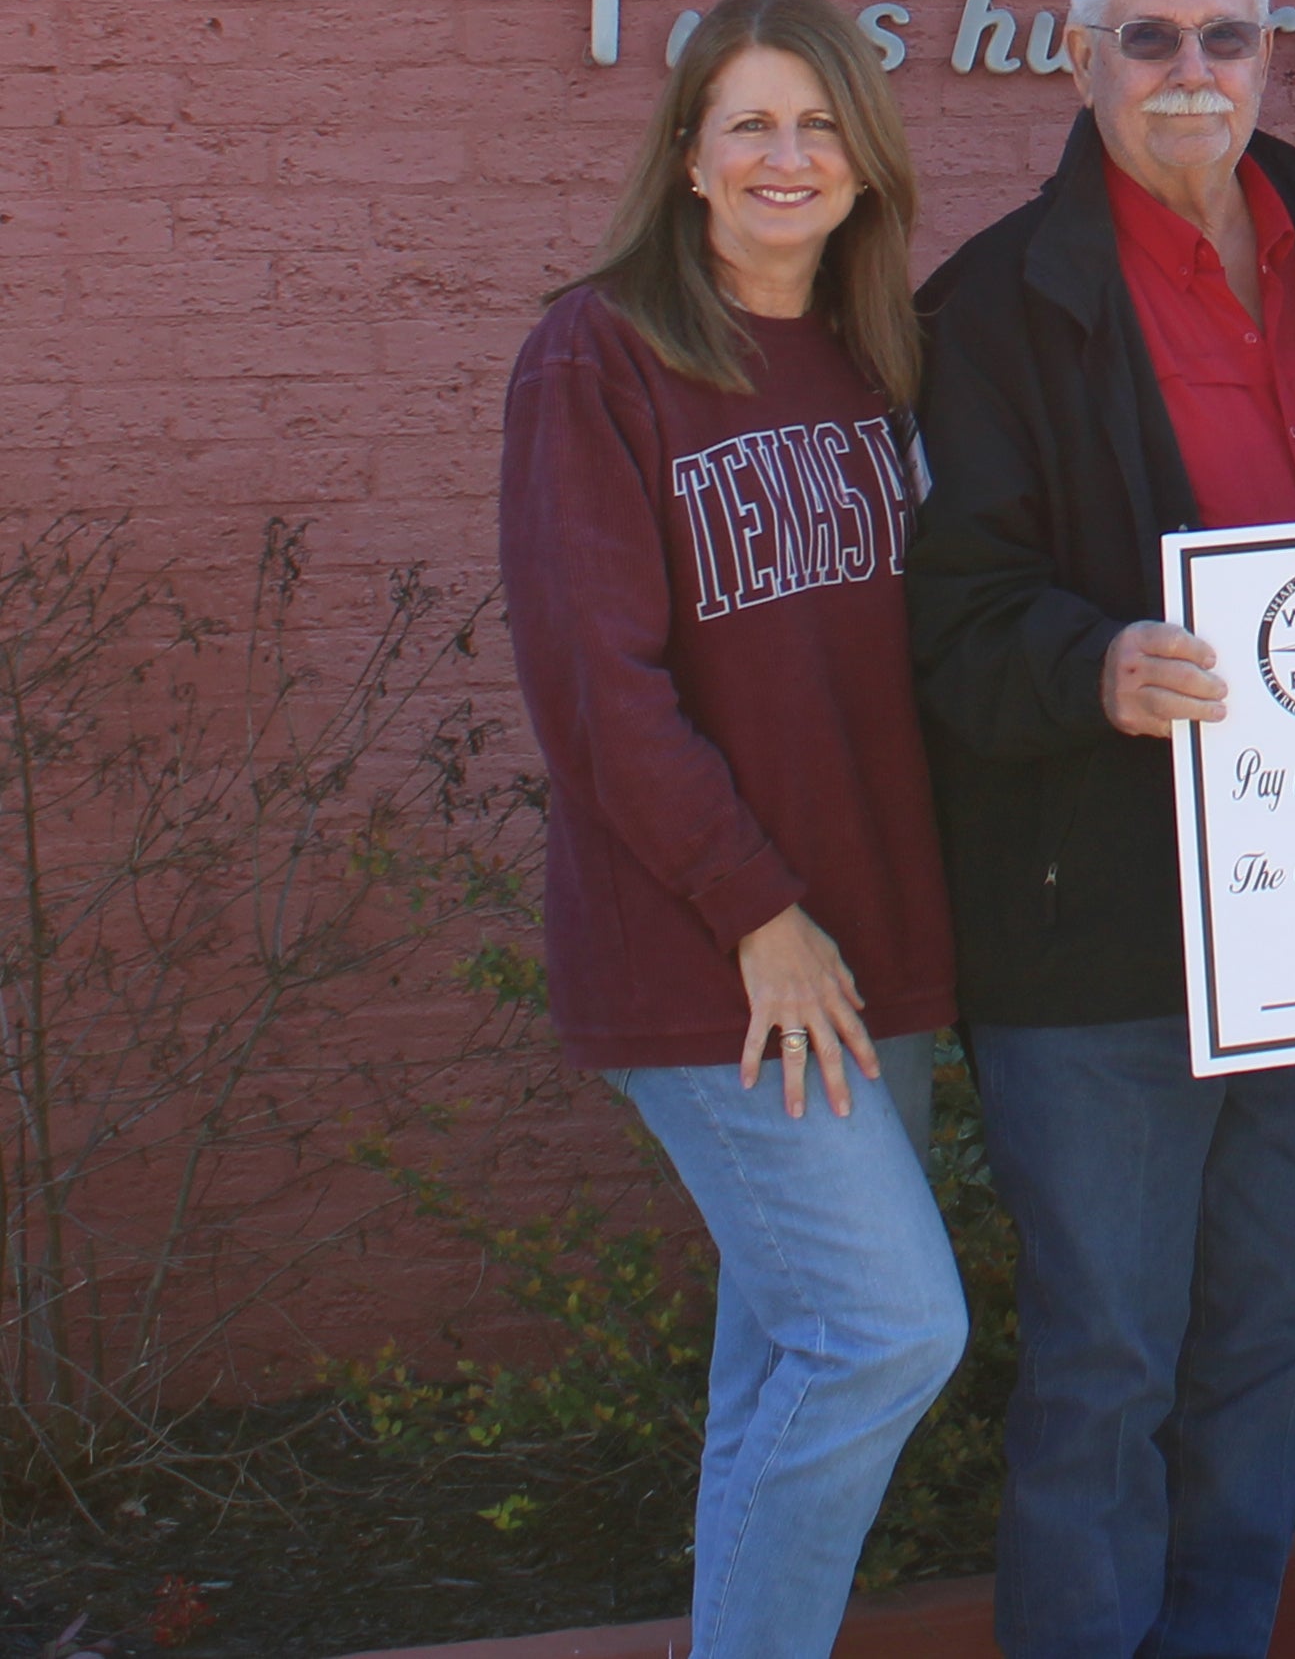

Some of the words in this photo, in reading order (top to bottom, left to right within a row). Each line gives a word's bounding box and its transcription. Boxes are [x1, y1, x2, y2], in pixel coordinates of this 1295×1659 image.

[672, 422, 876, 622] TEXAS
[1232, 747, 1286, 811] Pay
[1229, 851, 1287, 894] The
